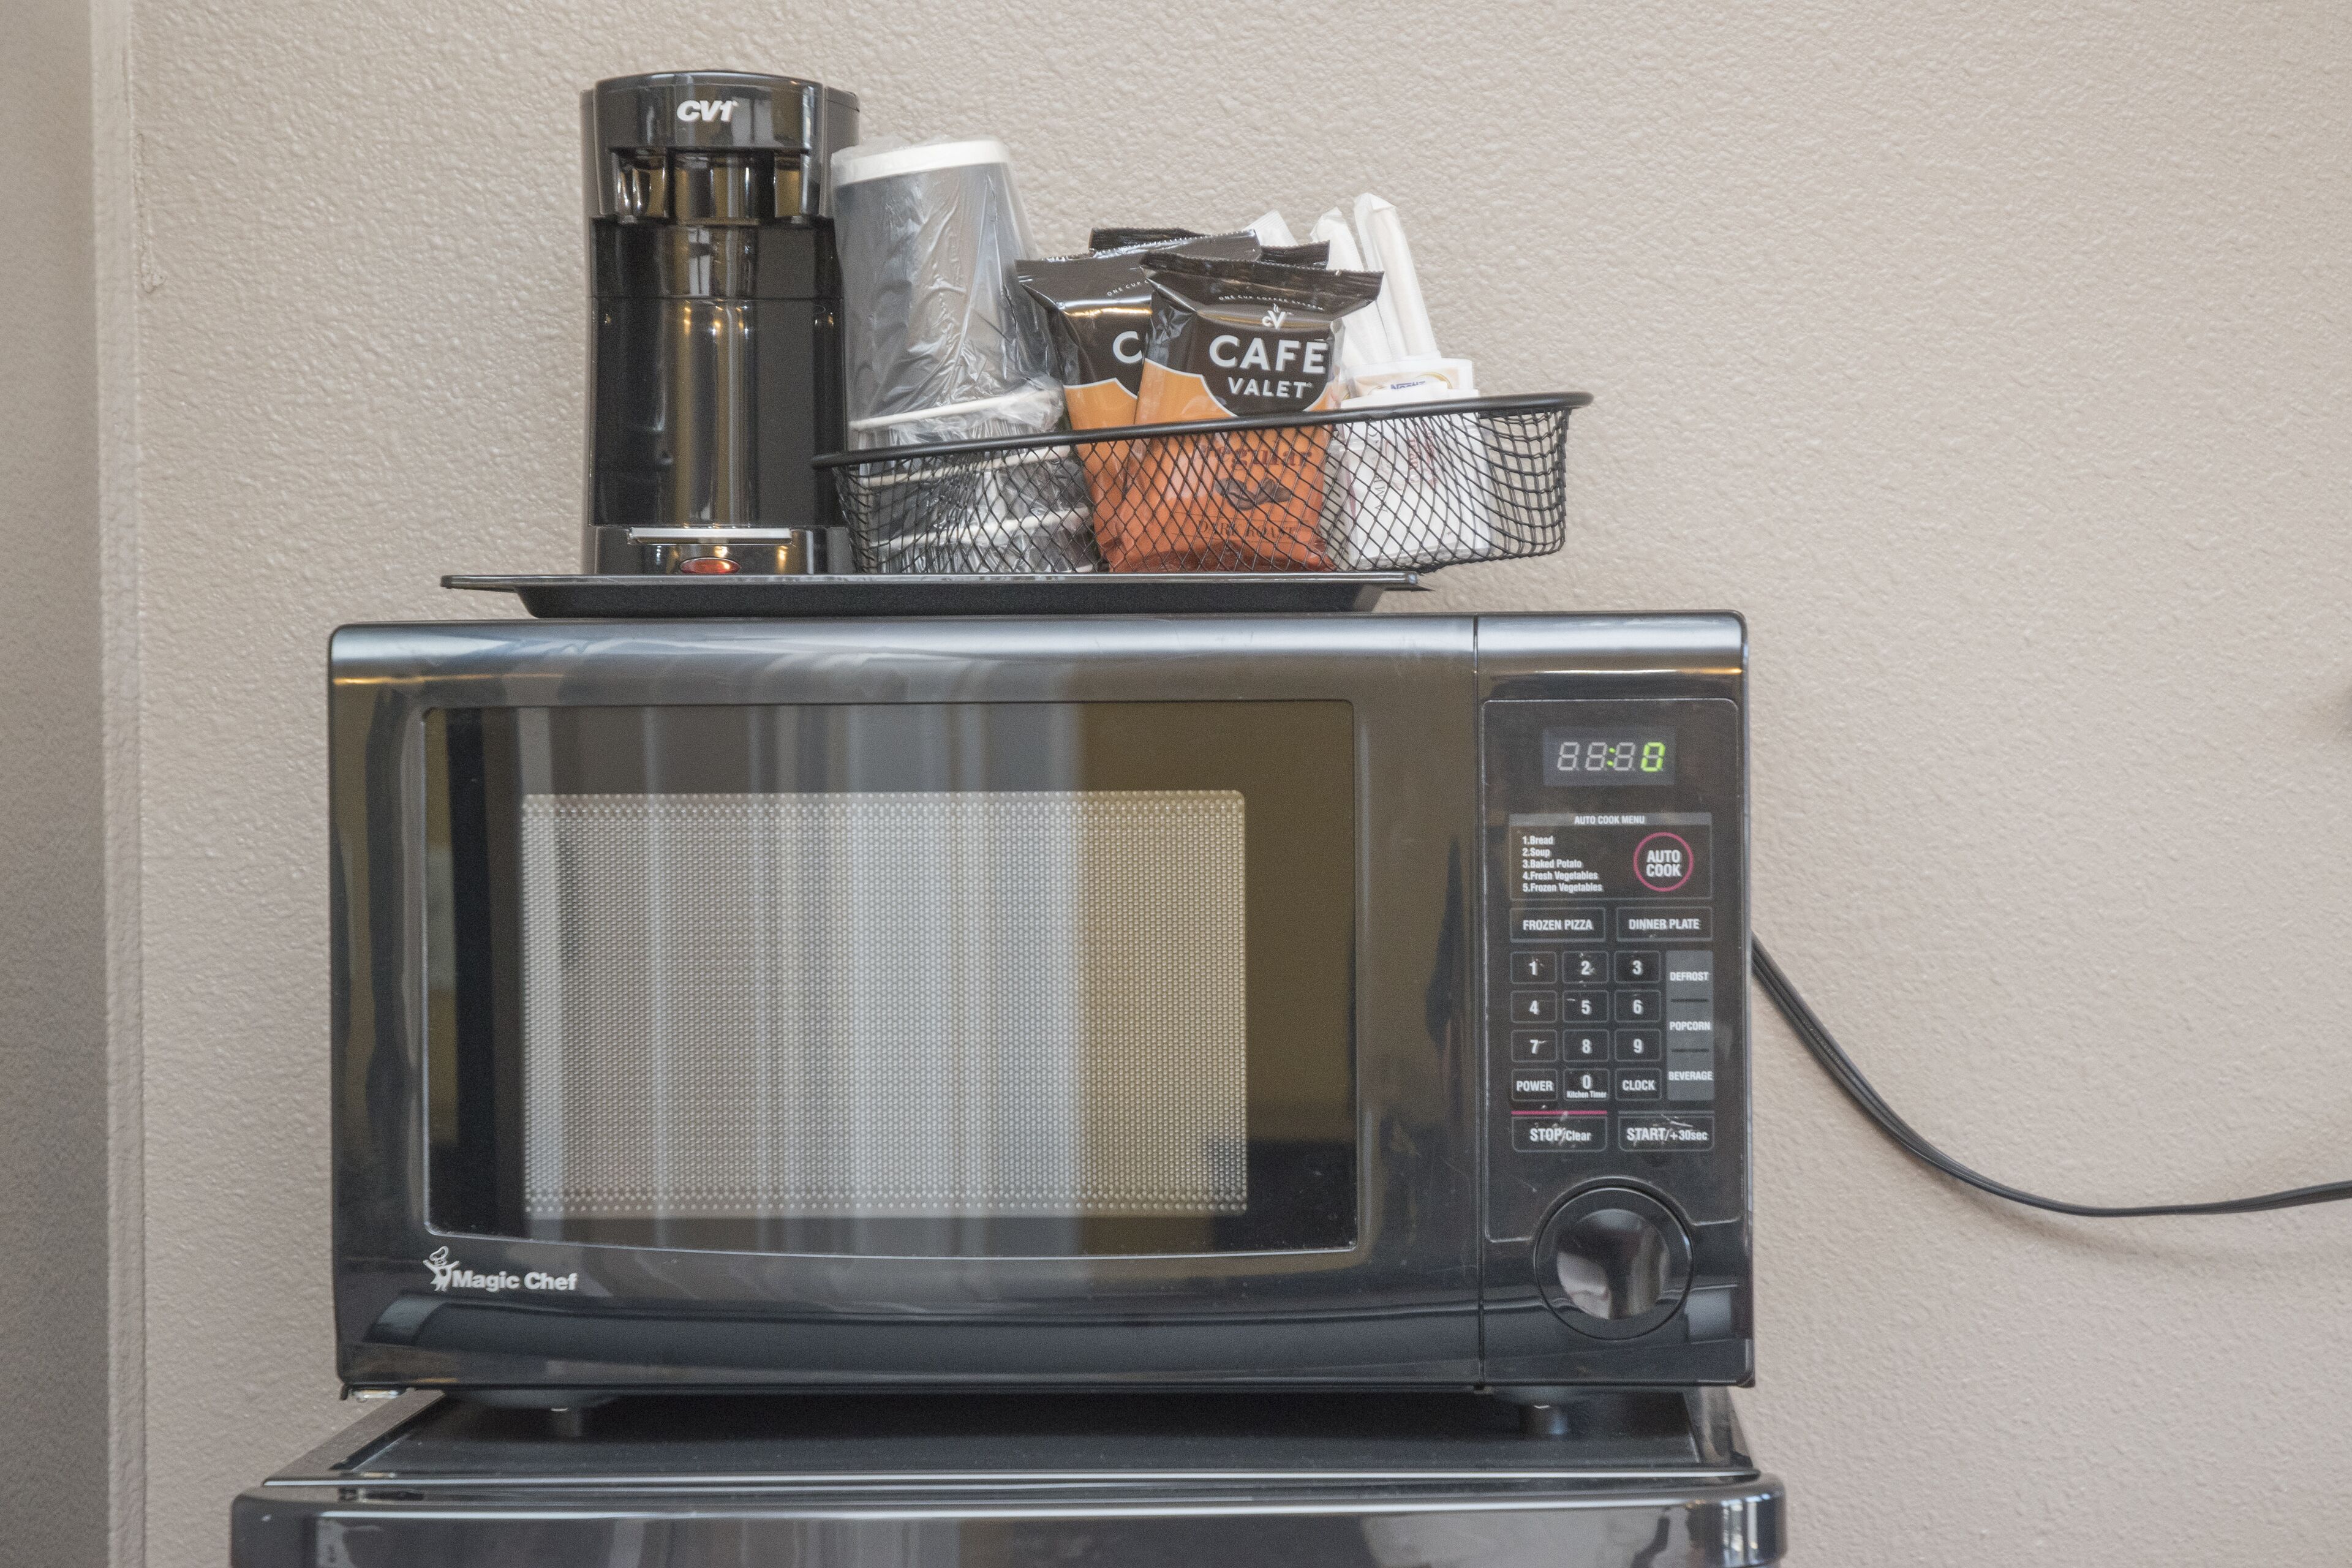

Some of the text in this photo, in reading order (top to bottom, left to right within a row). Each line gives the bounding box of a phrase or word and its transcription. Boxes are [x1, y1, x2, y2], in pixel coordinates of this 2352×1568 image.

[1575, 815, 1645, 824] AUTO COOK MENU
[1522, 835, 1554, 845] 1.Bread
[1522, 847, 1550, 858] 2.Soup
[1647, 850, 1681, 863] AUTO
[1522, 859, 1582, 868] 3.Baked Potato
[1522, 870, 1599, 882] 4.Fresh Vegetables
[1646, 864, 1681, 877] COOK
[1522, 883, 1602, 894] 5.Frozen Vegetables
[1523, 920, 1593, 930] FROZEN PIZZA
[1629, 919, 1700, 930] DINNER PLATE
[1529, 960, 1538, 976] 1
[1581, 960, 1591, 975] 2
[1633, 960, 1642, 975] 3
[1670, 971, 1709, 981] DEFROST
[1529, 1000, 1539, 1014] 4
[1581, 1000, 1591, 1014] 5
[1633, 999, 1642, 1014] 6
[1670, 1021, 1711, 1031] POPCORN
[1530, 1039, 1539, 1054] 7
[1582, 1039, 1591, 1054] 8
[1634, 1039, 1643, 1054] 9
[1669, 1071, 1713, 1080] BEVERAGE
[1517, 1080, 1553, 1092] POWER
[1583, 1075, 1591, 1090] 0
[1623, 1080, 1655, 1091] CLOCK
[1591, 1090, 1607, 1099] Timer
[1530, 1128, 1591, 1142] STOP/Clear
[452, 1270, 578, 1292] Magic Chef
